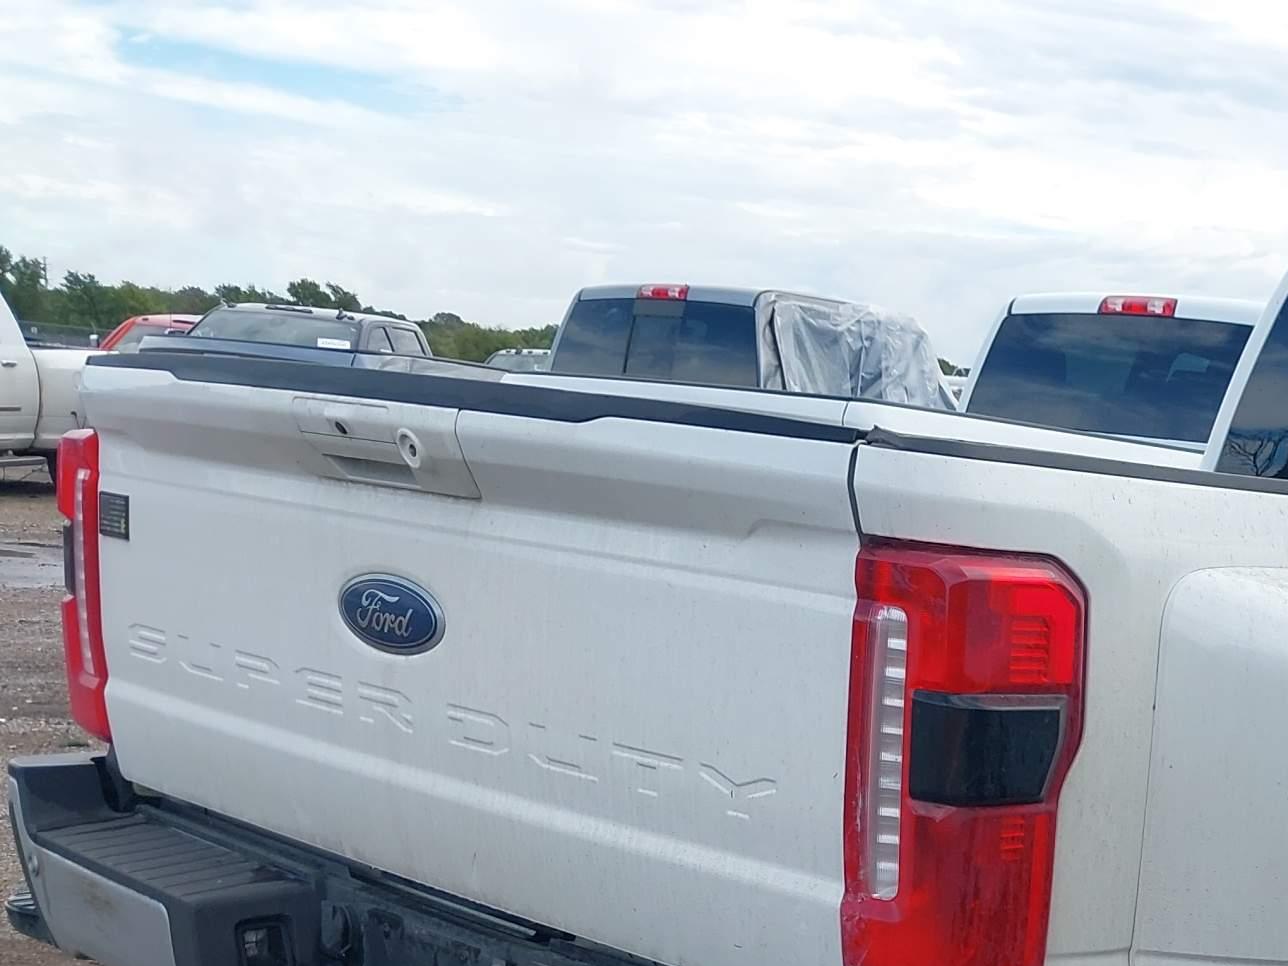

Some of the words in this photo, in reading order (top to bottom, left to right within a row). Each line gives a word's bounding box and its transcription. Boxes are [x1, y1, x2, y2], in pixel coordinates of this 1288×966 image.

[356, 589, 413, 637] Ford
[127, 622, 414, 734] SUPER
[447, 702, 778, 819] DUTY
